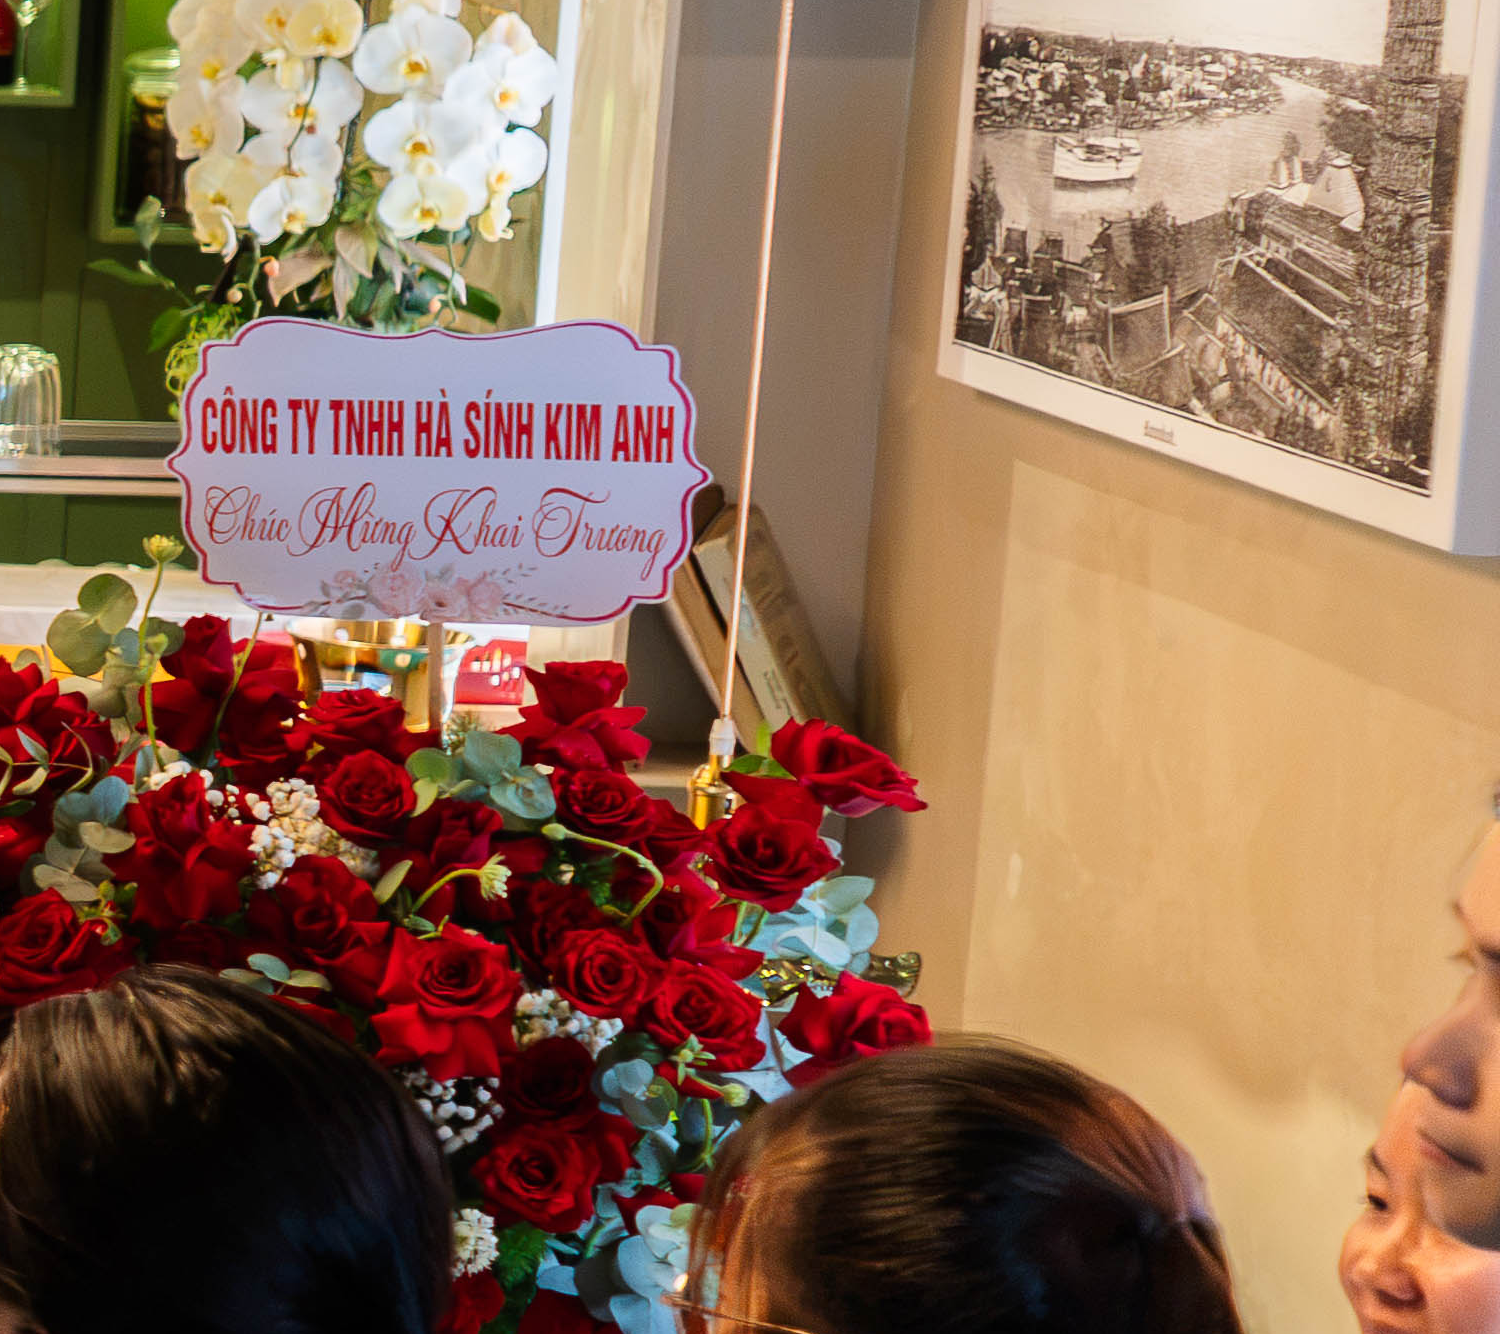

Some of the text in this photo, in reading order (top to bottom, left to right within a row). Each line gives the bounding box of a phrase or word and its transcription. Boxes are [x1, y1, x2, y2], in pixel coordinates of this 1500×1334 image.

[201, 385, 676, 464] CÔNG TY TNHH HÀ SÍNH KIM ANH
[203, 481, 669, 581] Chúc Mừng Khai Trương
